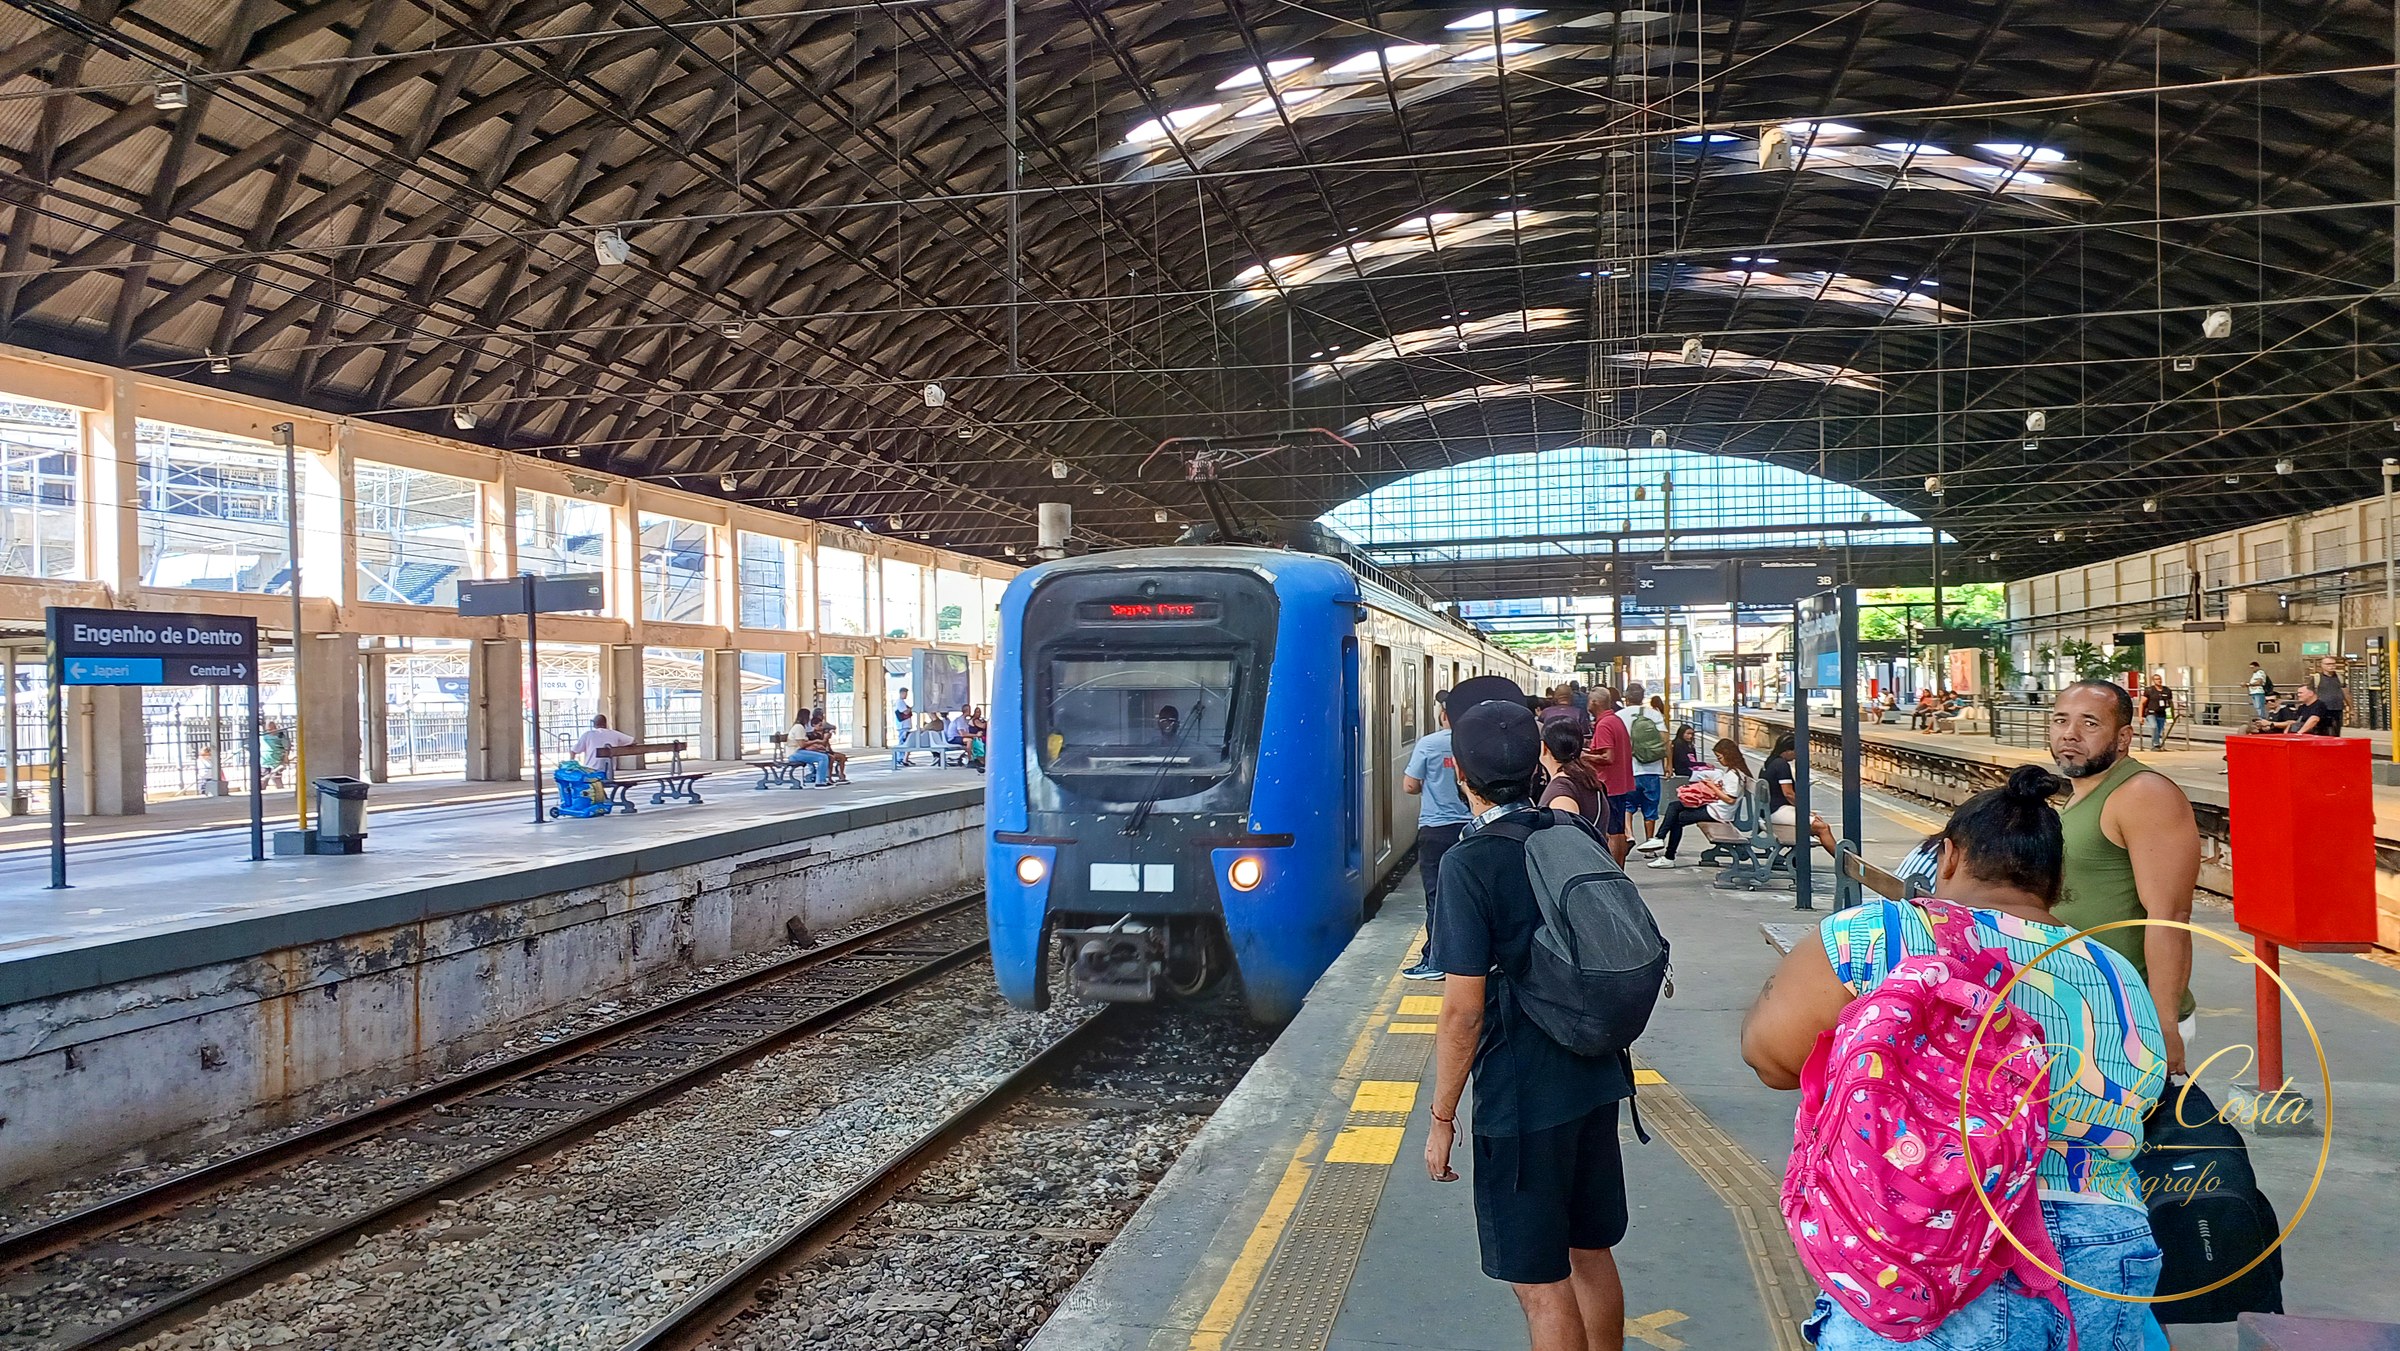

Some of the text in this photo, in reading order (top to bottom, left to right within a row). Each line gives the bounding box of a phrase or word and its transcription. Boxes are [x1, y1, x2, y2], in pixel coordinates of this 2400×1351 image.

[1639, 580, 1655, 589] 3C
[1816, 576, 1832, 586] 3B
[73, 624, 243, 646] Engenho de Dentro
[90, 664, 130, 679] Japeri
[189, 664, 231, 677] Central
